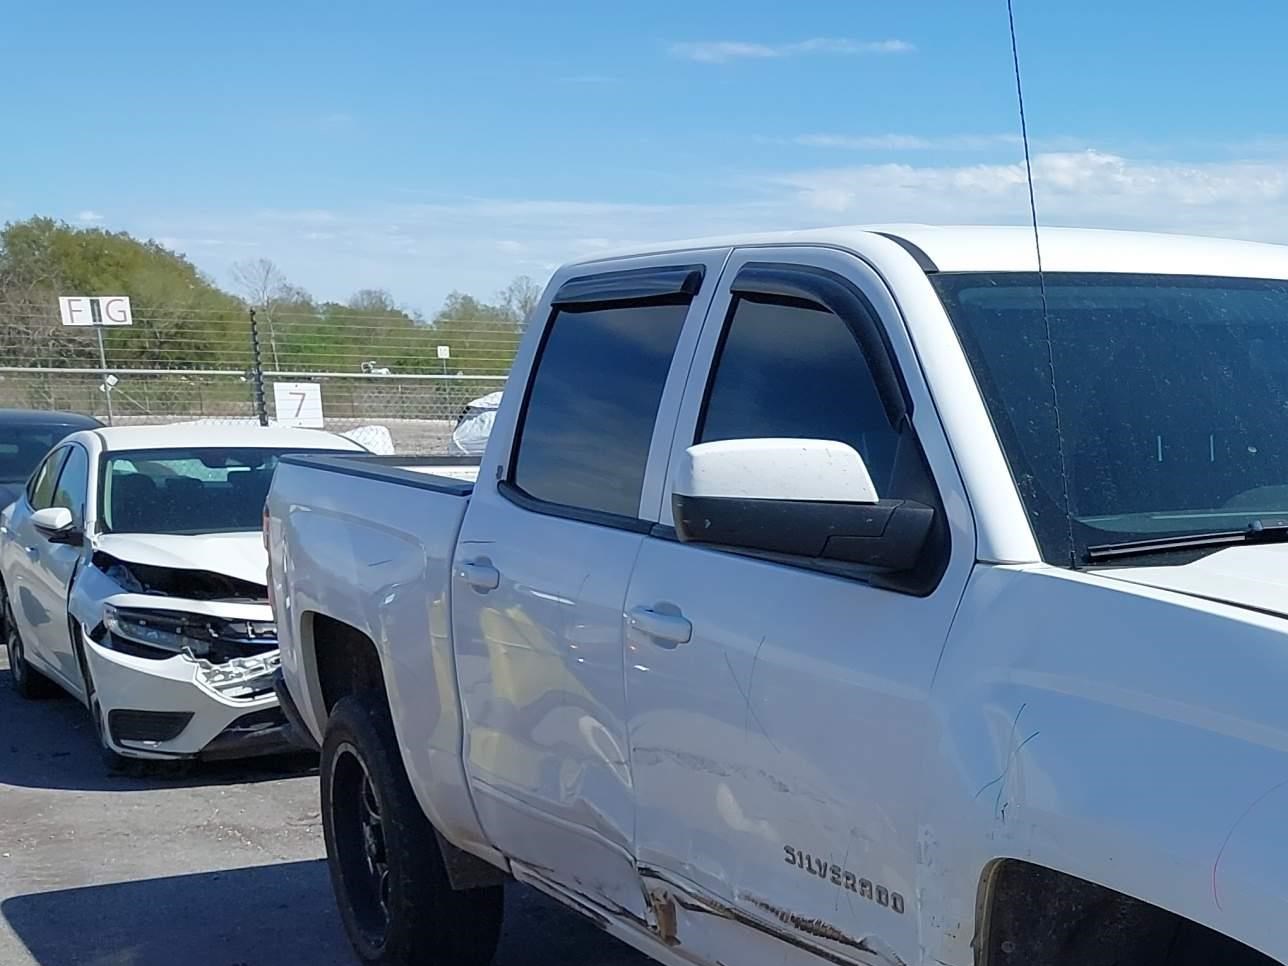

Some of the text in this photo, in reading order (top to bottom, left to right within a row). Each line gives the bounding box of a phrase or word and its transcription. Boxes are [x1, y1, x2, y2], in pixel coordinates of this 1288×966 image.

[68, 298, 127, 324] F G
[289, 391, 306, 418] 7
[783, 844, 906, 915] SILVERADO
